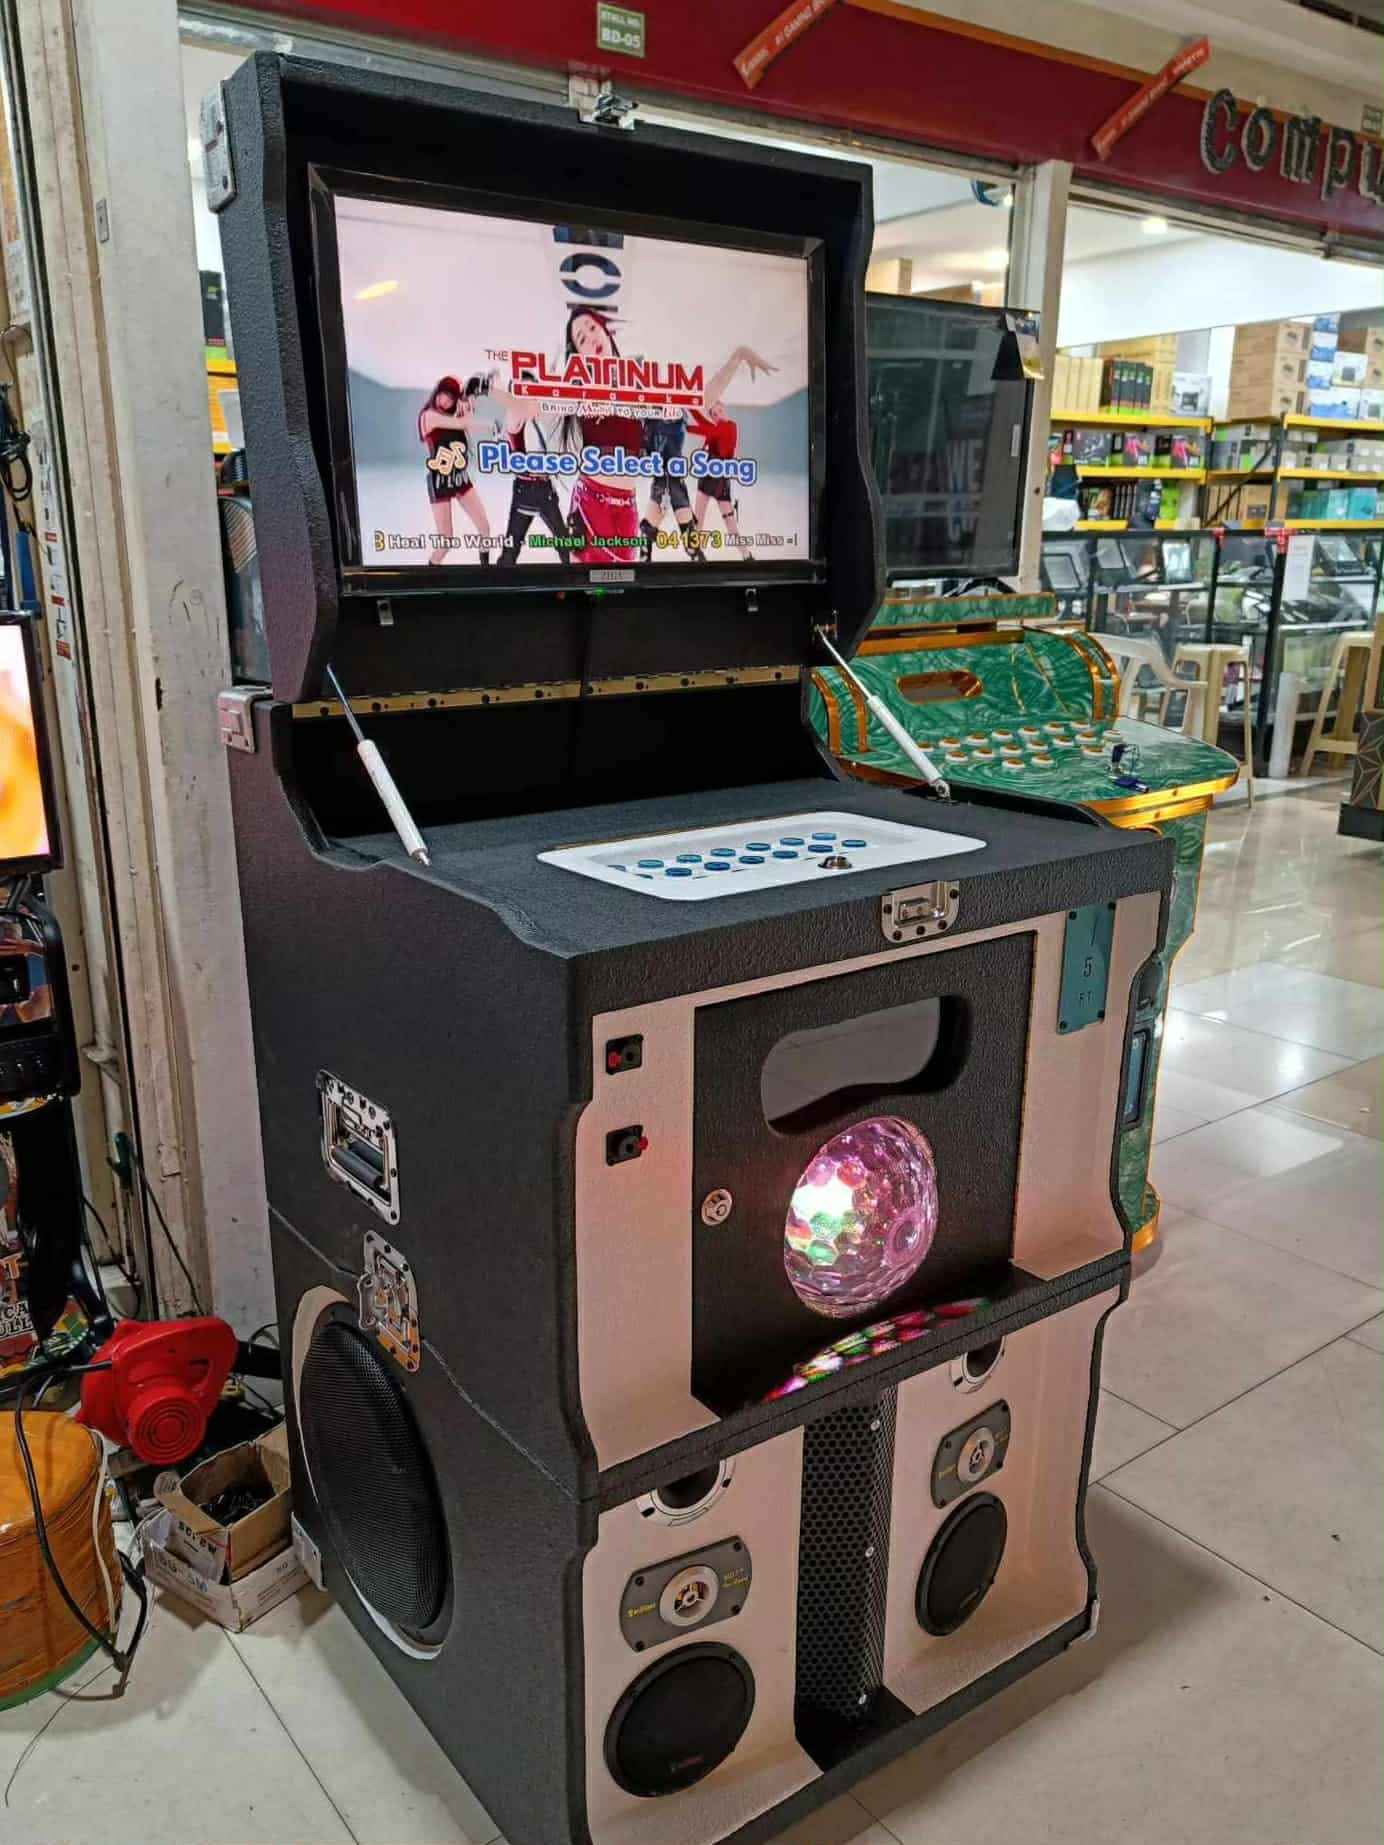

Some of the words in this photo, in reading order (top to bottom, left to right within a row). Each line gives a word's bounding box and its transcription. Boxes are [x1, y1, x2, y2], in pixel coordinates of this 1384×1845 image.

[601, 28, 641, 49] BD-05
[485, 350, 509, 361] THE
[511, 350, 704, 391] PLATINUM
[479, 441, 579, 475] Please
[580, 445, 662, 476] Select
[666, 456, 687, 476] a
[691, 452, 757, 485] Song
[388, 533, 425, 549] Heal
[429, 534, 461, 549] The
[464, 534, 514, 549] World
[528, 533, 585, 550] Michael
[591, 533, 649, 548] Jackson
[655, 530, 722, 549] 041373
[725, 533, 754, 547] Miss
[755, 533, 784, 547] Miss
